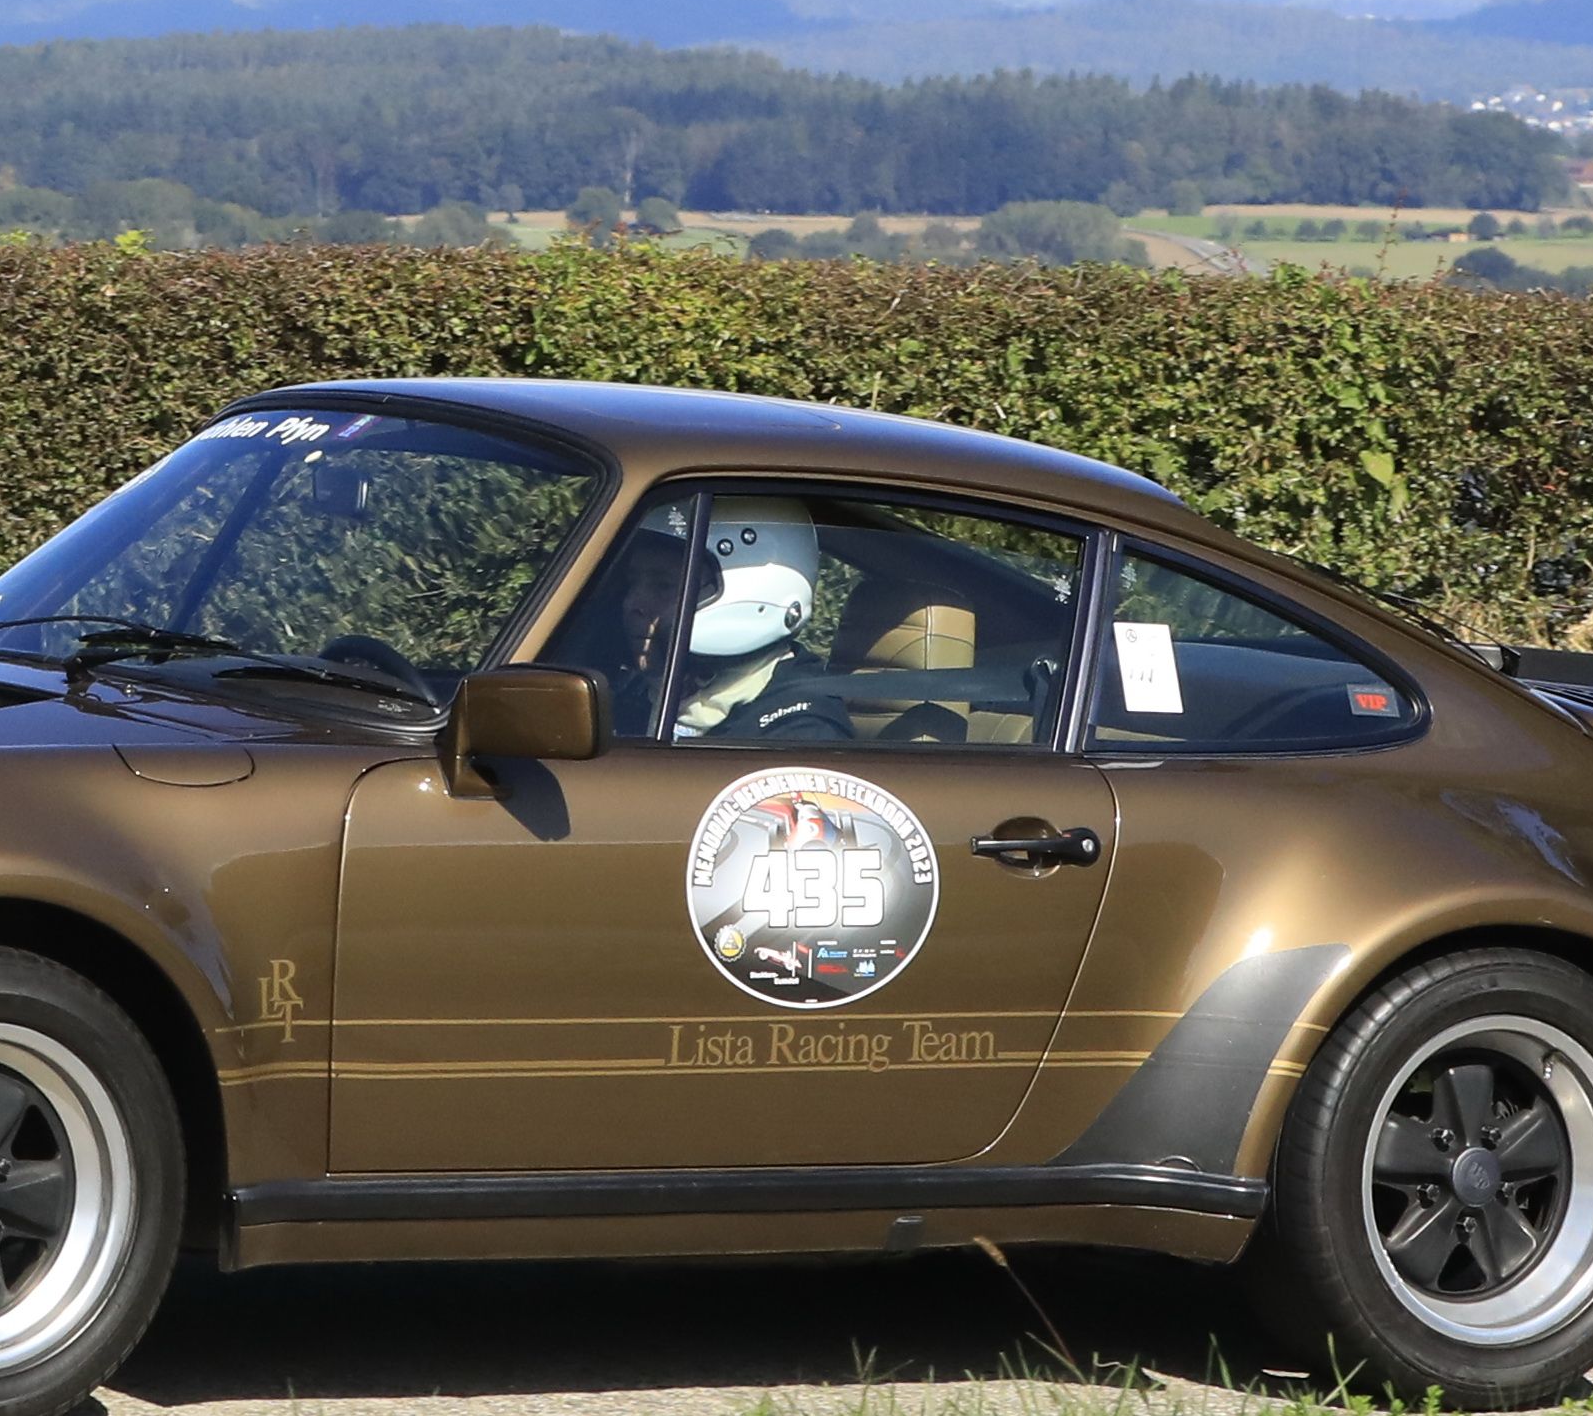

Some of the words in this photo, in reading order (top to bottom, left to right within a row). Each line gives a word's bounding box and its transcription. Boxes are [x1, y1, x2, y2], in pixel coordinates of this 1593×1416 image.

[265, 417, 330, 445] Pfyn
[1355, 693, 1387, 711] VIP
[828, 777, 915, 840] STECKBORN
[904, 833, 933, 884] 2023
[742, 849, 885, 928] 435
[667, 1024, 755, 1066] Lista
[766, 1022, 892, 1072] Racing
[902, 1020, 998, 1063] Team
